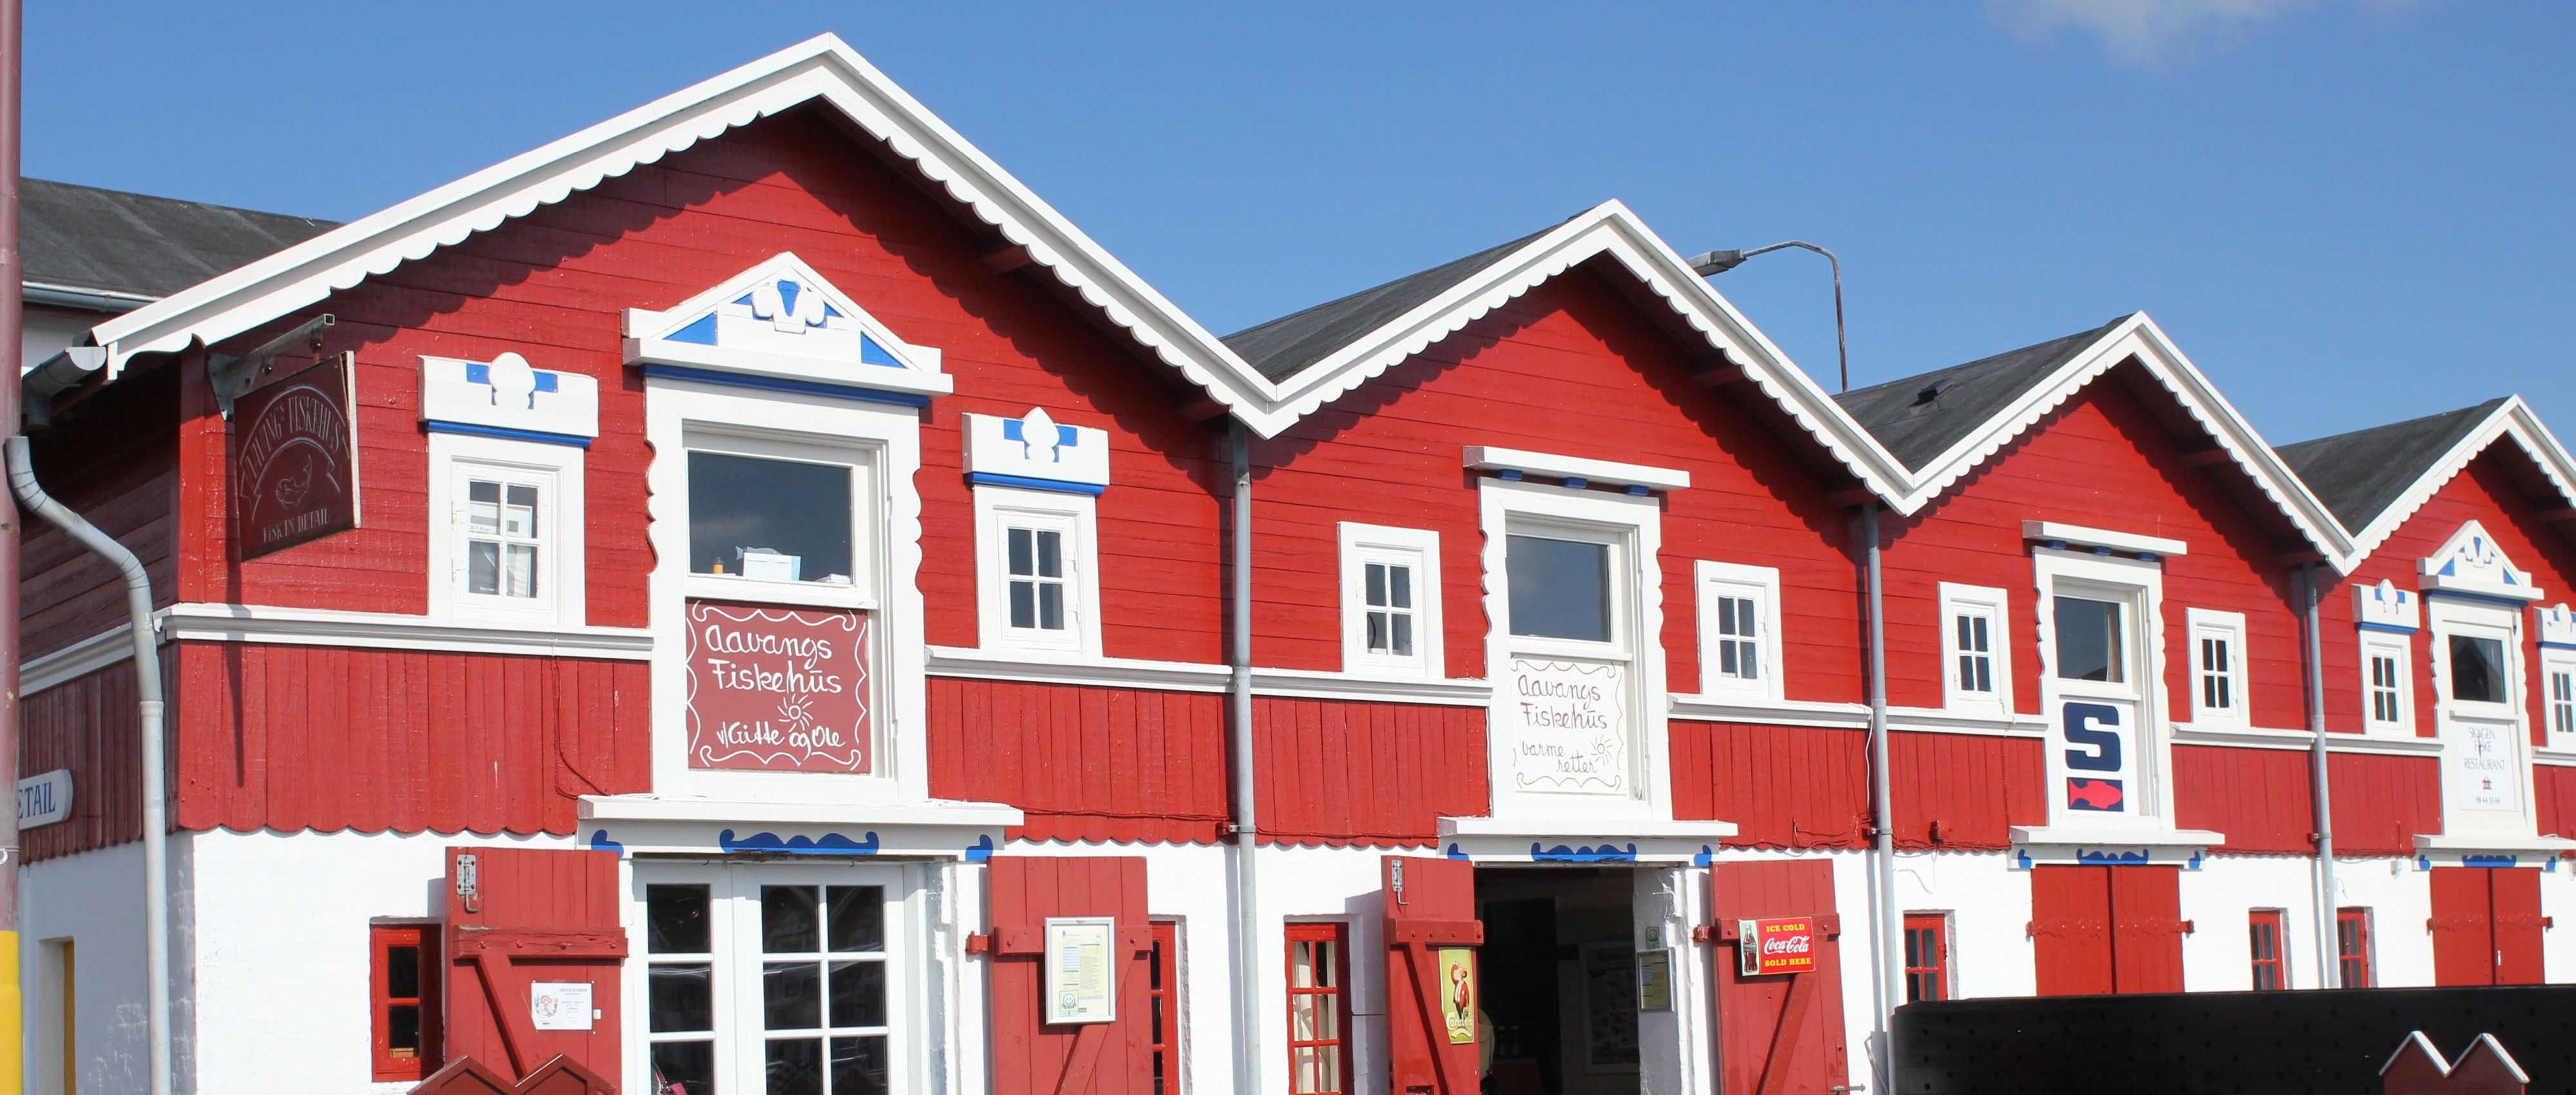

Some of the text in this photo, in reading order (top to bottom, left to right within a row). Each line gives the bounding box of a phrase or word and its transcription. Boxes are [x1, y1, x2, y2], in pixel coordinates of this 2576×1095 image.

[289, 395, 341, 453] FISKEHUS
[263, 508, 329, 543] FISK EN DETAIL
[811, 725, 846, 747] Ole
[2063, 701, 2121, 772] S
[2468, 727, 2496, 739] SKAGEN
[1522, 741, 1565, 757] varme
[2474, 740, 2492, 752] FSKE
[1556, 749, 1598, 773] retter
[2463, 757, 2506, 770] RESTAURANT
[1764, 935, 1810, 955] Coca-Cola
[1765, 957, 1812, 967] SOLD HERE
[1446, 1012, 1473, 1031] Carlsberg
